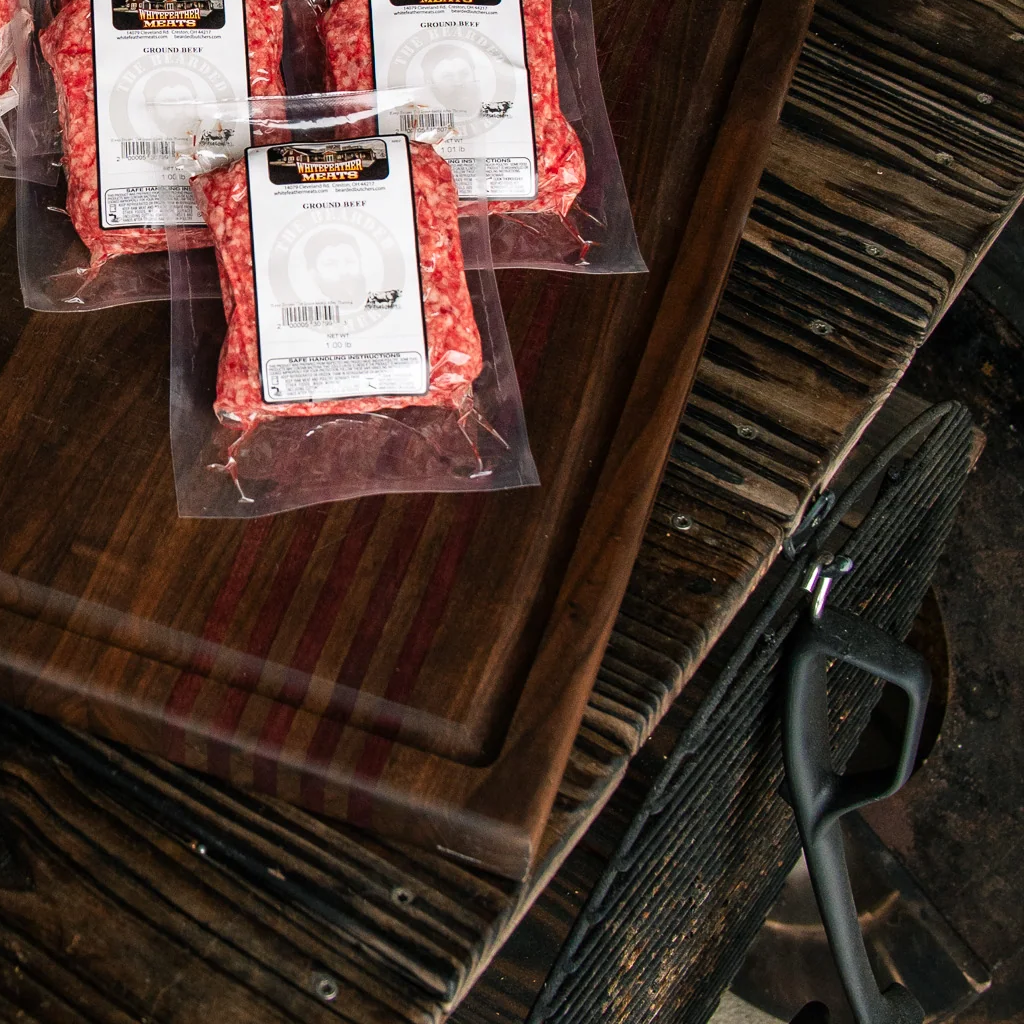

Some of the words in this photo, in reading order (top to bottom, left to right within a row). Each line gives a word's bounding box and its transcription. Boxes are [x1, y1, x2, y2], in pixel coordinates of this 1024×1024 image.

[139, 8, 201, 20] WHITEFEATHER
[143, 19, 197, 28] MEATS
[296, 158, 363, 174] WHITEFEATHER
[301, 171, 359, 182] MEATS
